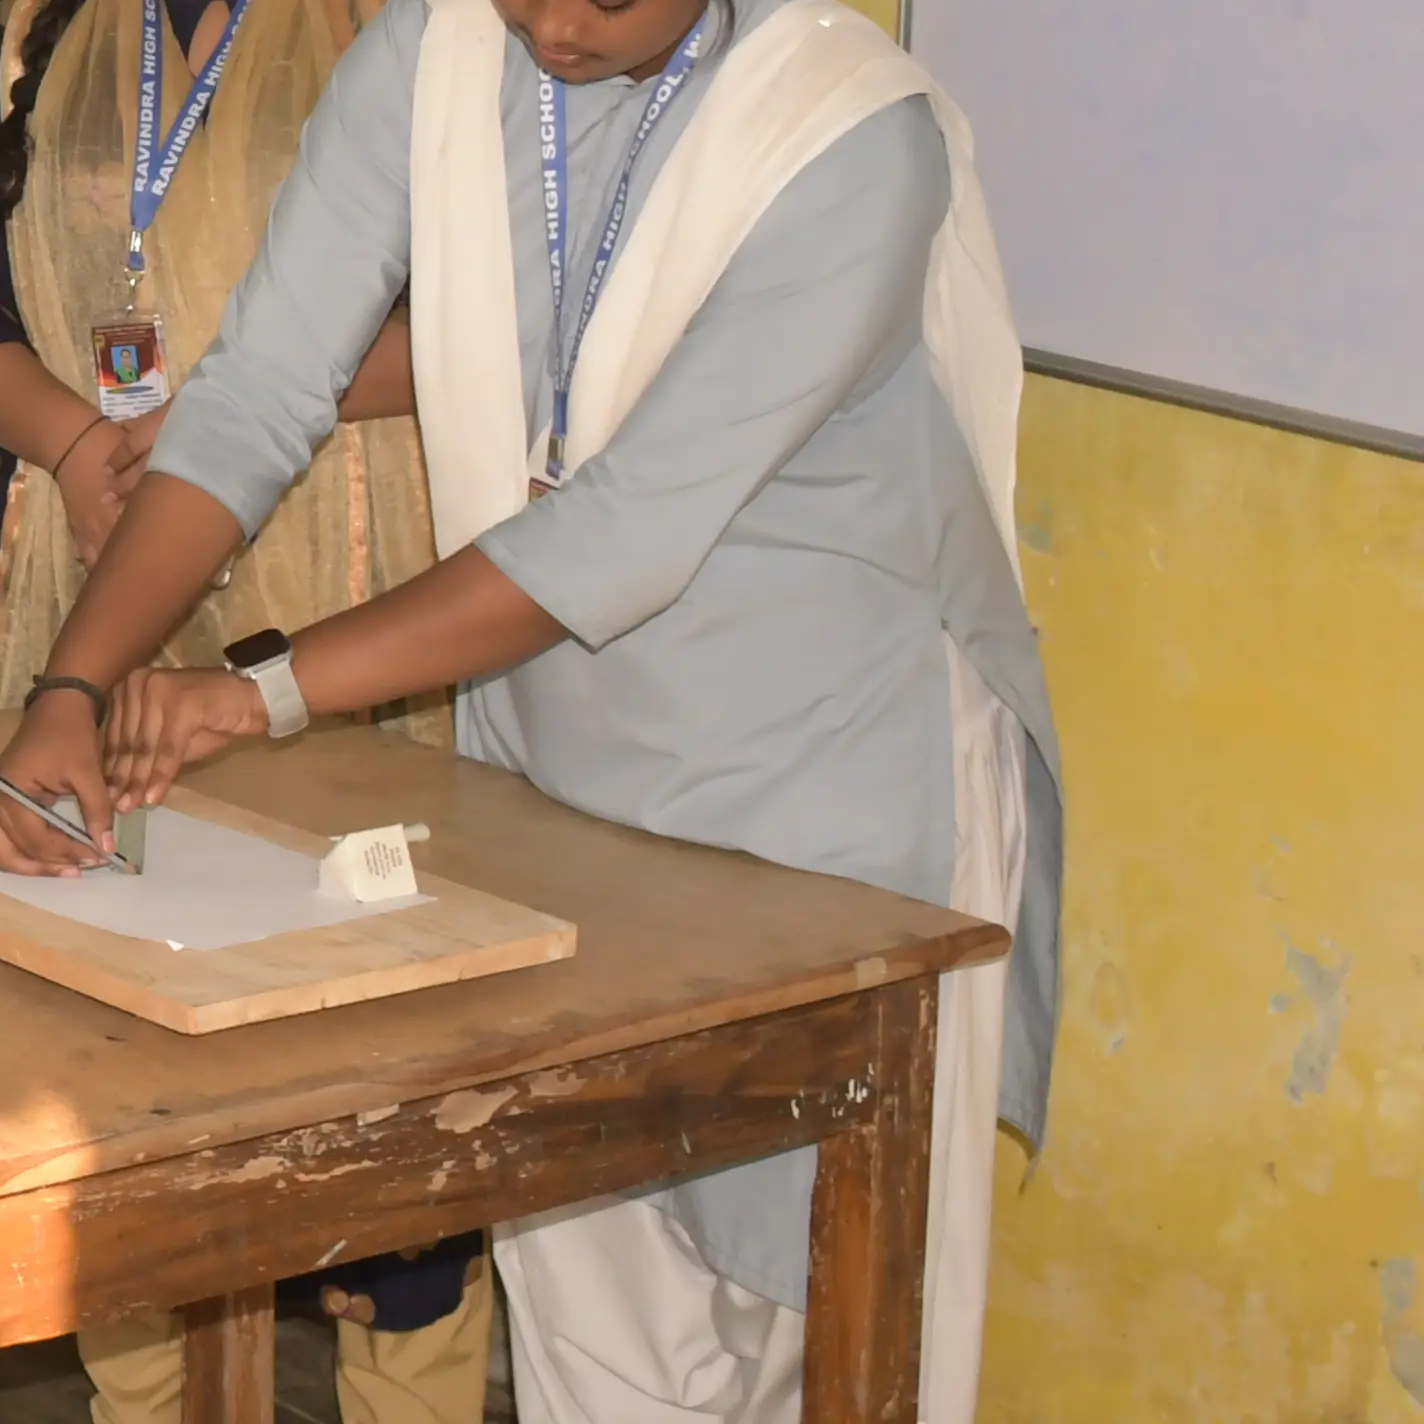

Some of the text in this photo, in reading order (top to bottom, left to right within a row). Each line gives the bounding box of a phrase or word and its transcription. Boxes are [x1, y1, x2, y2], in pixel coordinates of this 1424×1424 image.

[143, 26, 156, 75] HIGH
[134, 81, 155, 192] RAVINDRA
[151, 91, 211, 196] RAVINDRA
[544, 170, 559, 240] HIGH
